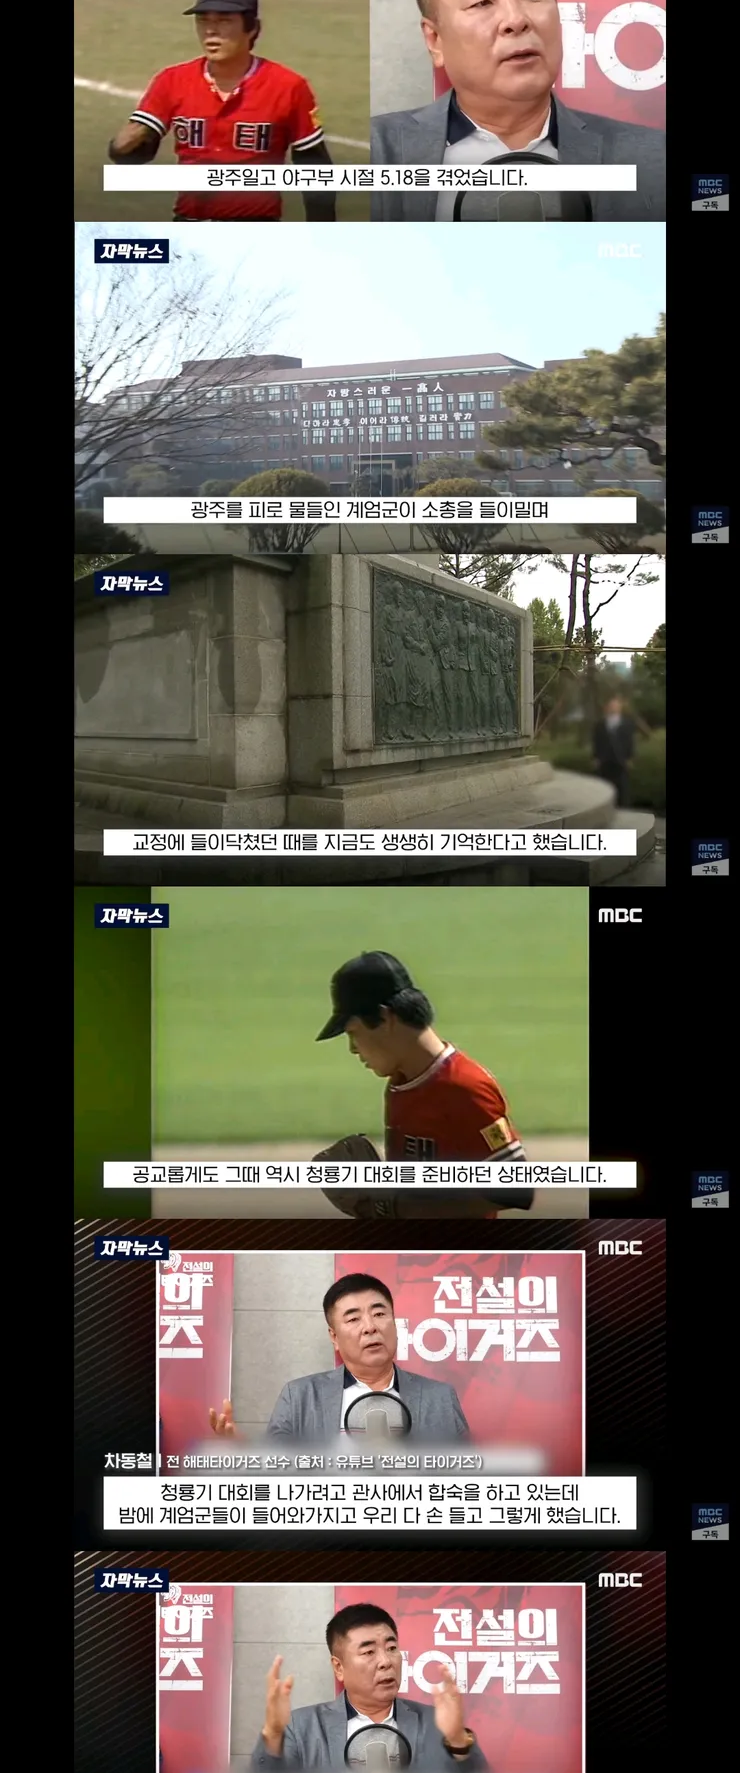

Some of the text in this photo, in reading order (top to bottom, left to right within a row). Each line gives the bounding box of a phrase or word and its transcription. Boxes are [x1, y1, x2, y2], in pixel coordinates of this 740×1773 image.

[326, 385, 392, 398] 자랑스러운
[433, 1276, 558, 1314] 전설의
[433, 1608, 558, 1646] 전설의
